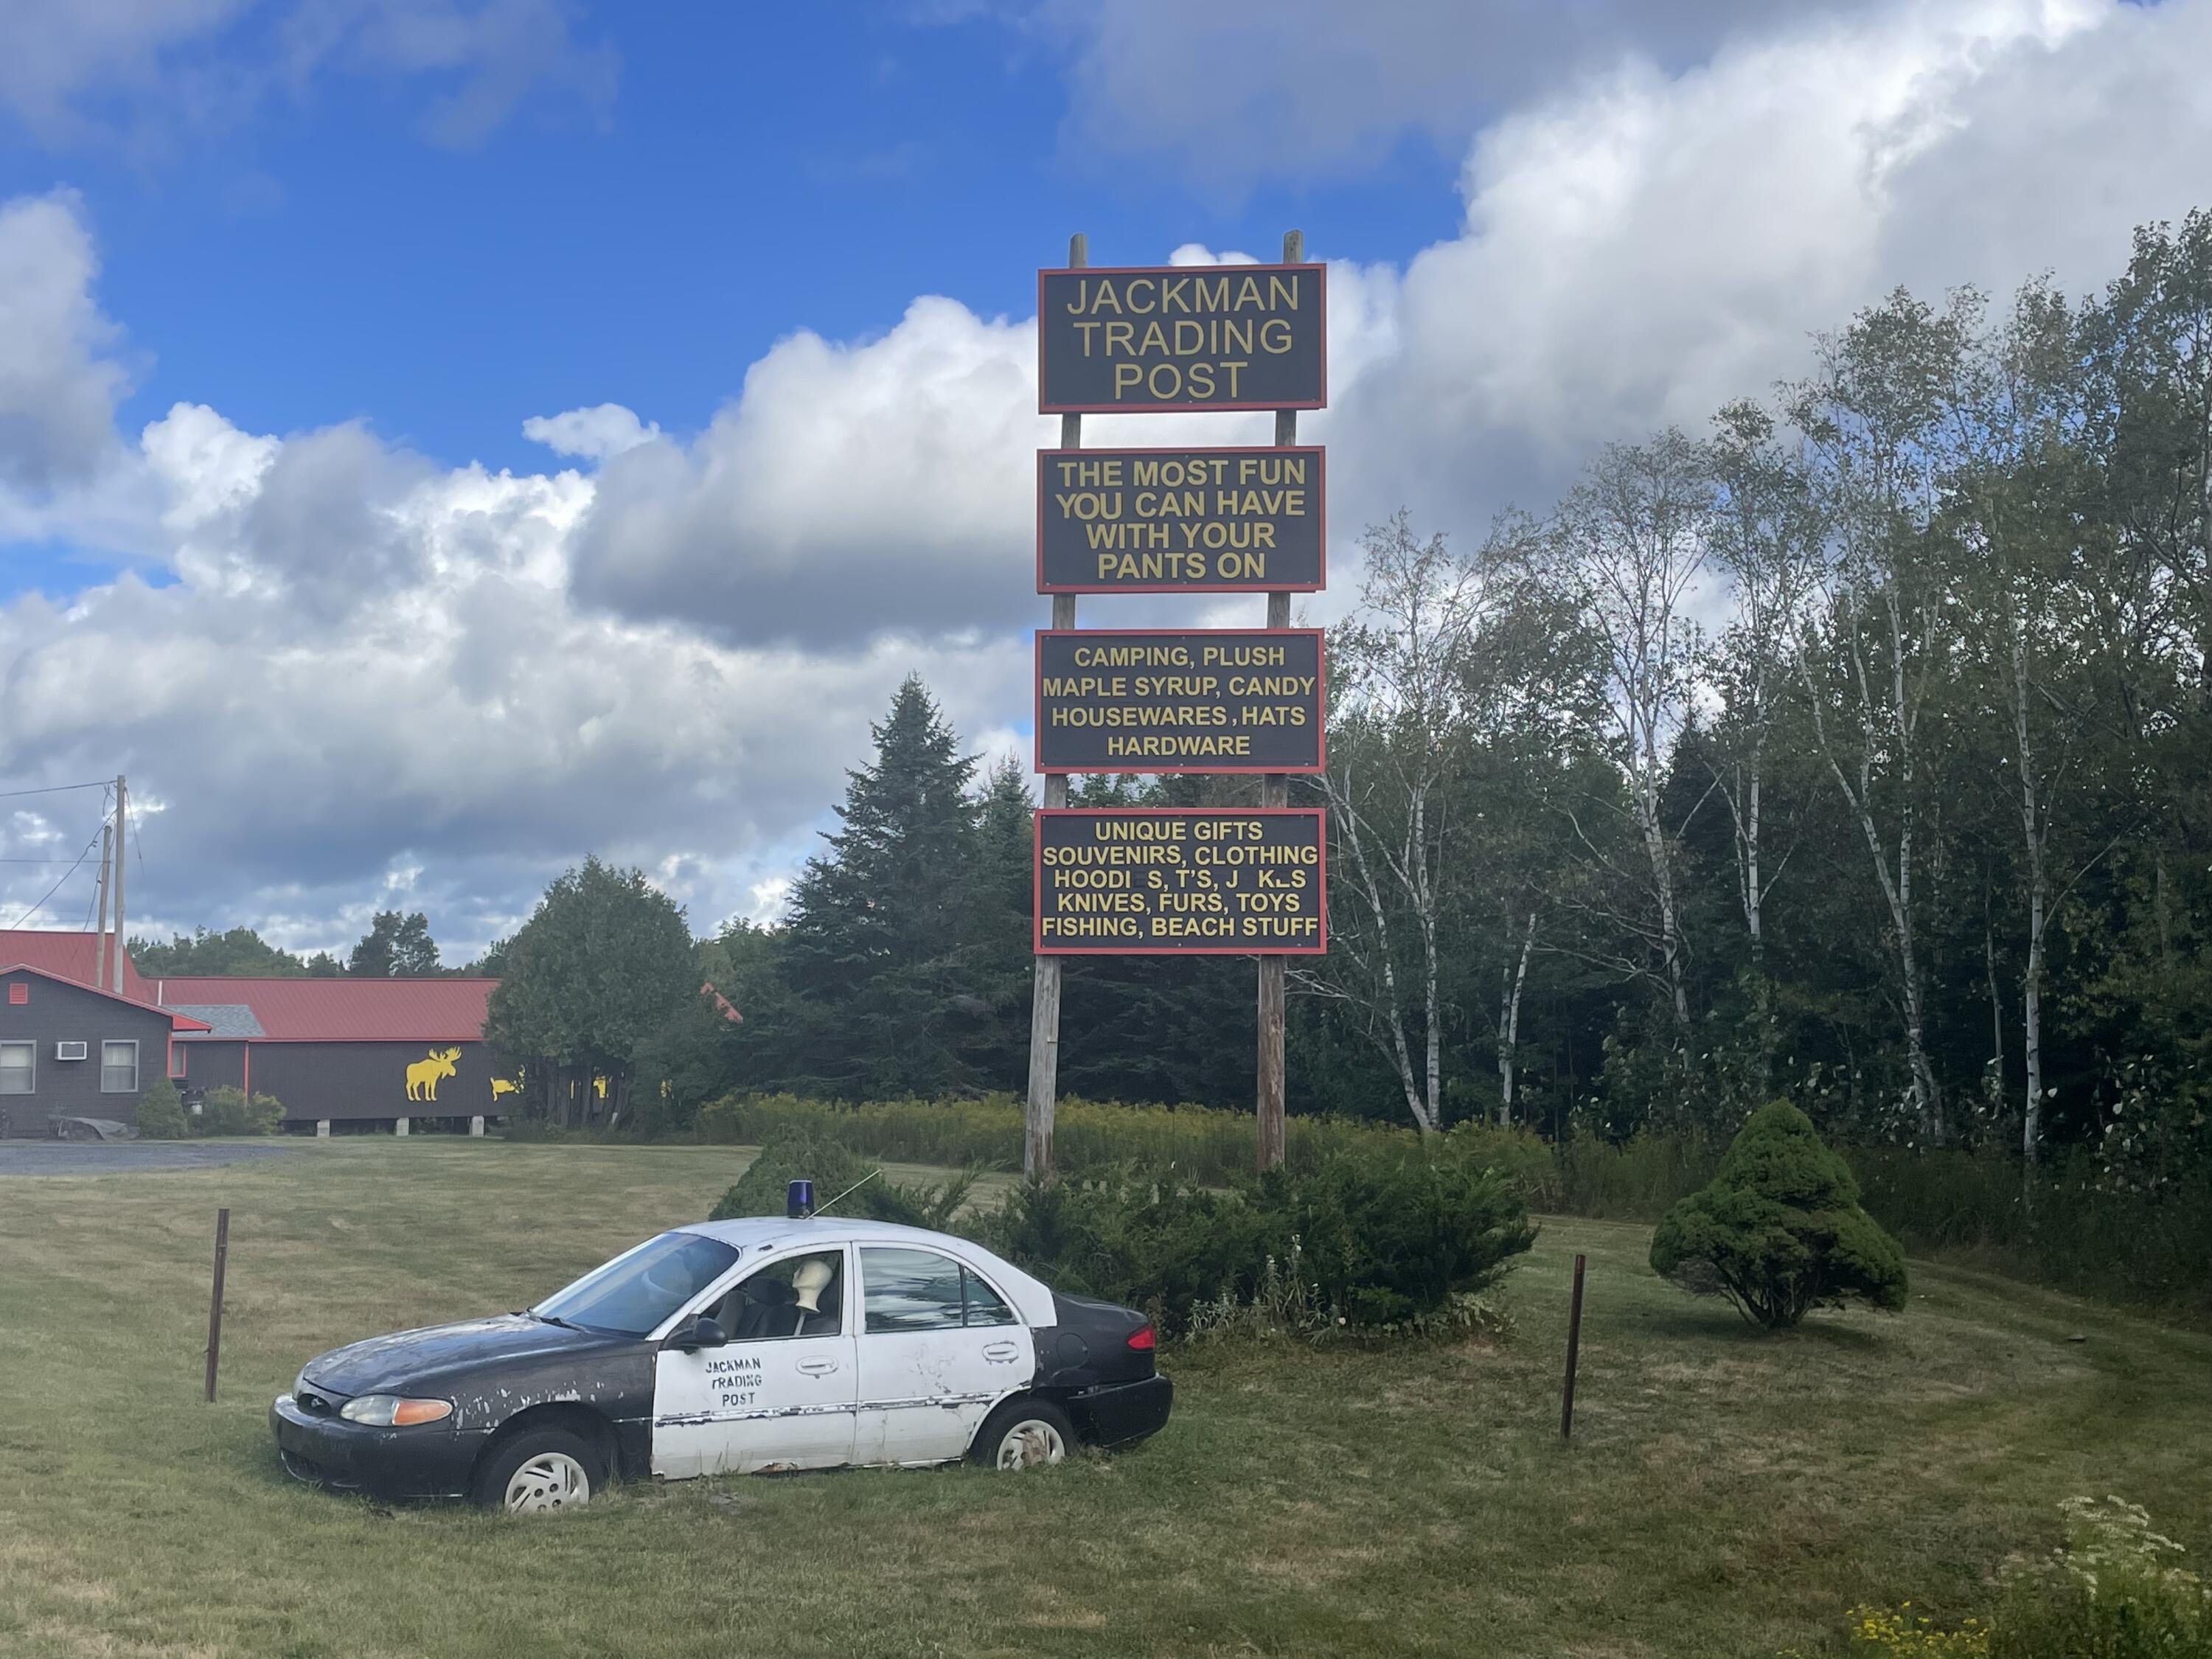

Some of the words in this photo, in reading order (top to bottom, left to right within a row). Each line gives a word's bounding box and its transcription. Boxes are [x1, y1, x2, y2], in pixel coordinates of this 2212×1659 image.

[1067, 275, 1298, 314] JACKMAN
[1073, 319, 1292, 356] TRADING
[1115, 361, 1248, 399] POST
[1057, 461, 1123, 487] THE
[1133, 459, 1229, 487] MOST
[1239, 459, 1305, 485] FUN
[1055, 492, 1122, 520] YOU
[1135, 490, 1205, 518] CAN
[1217, 490, 1305, 515] HAVE
[1085, 523, 1169, 549] WITH
[1179, 522, 1276, 549] YOUR
[1098, 552, 1206, 579] PANTS
[1217, 552, 1265, 579] ON
[1074, 647, 1194, 669] CAMPING,
[1203, 647, 1284, 666] PLUSH
[1043, 677, 1127, 697] MAPLE
[1134, 676, 1221, 698] SYRUP,
[1228, 676, 1316, 696] CANDY
[1108, 735, 1251, 756] HARDWARE
[1096, 821, 1186, 842] UNIQUE
[1194, 821, 1263, 841] GIFTS
[1043, 844, 1187, 869] SOUVENIRS,
[1194, 845, 1318, 866] CLOTHING
[1054, 869, 1169, 892] HOODIS,
[1058, 893, 1151, 915] KNIVES,
[1159, 892, 1229, 915] FURS,
[1236, 893, 1300, 912] TOYS
[1042, 917, 1144, 939] FISHING,
[1152, 917, 1234, 936] BEACH
[1242, 917, 1318, 936] STUFF
[705, 1357, 762, 1374] JACKMAN
[722, 1391, 756, 1407] POST
